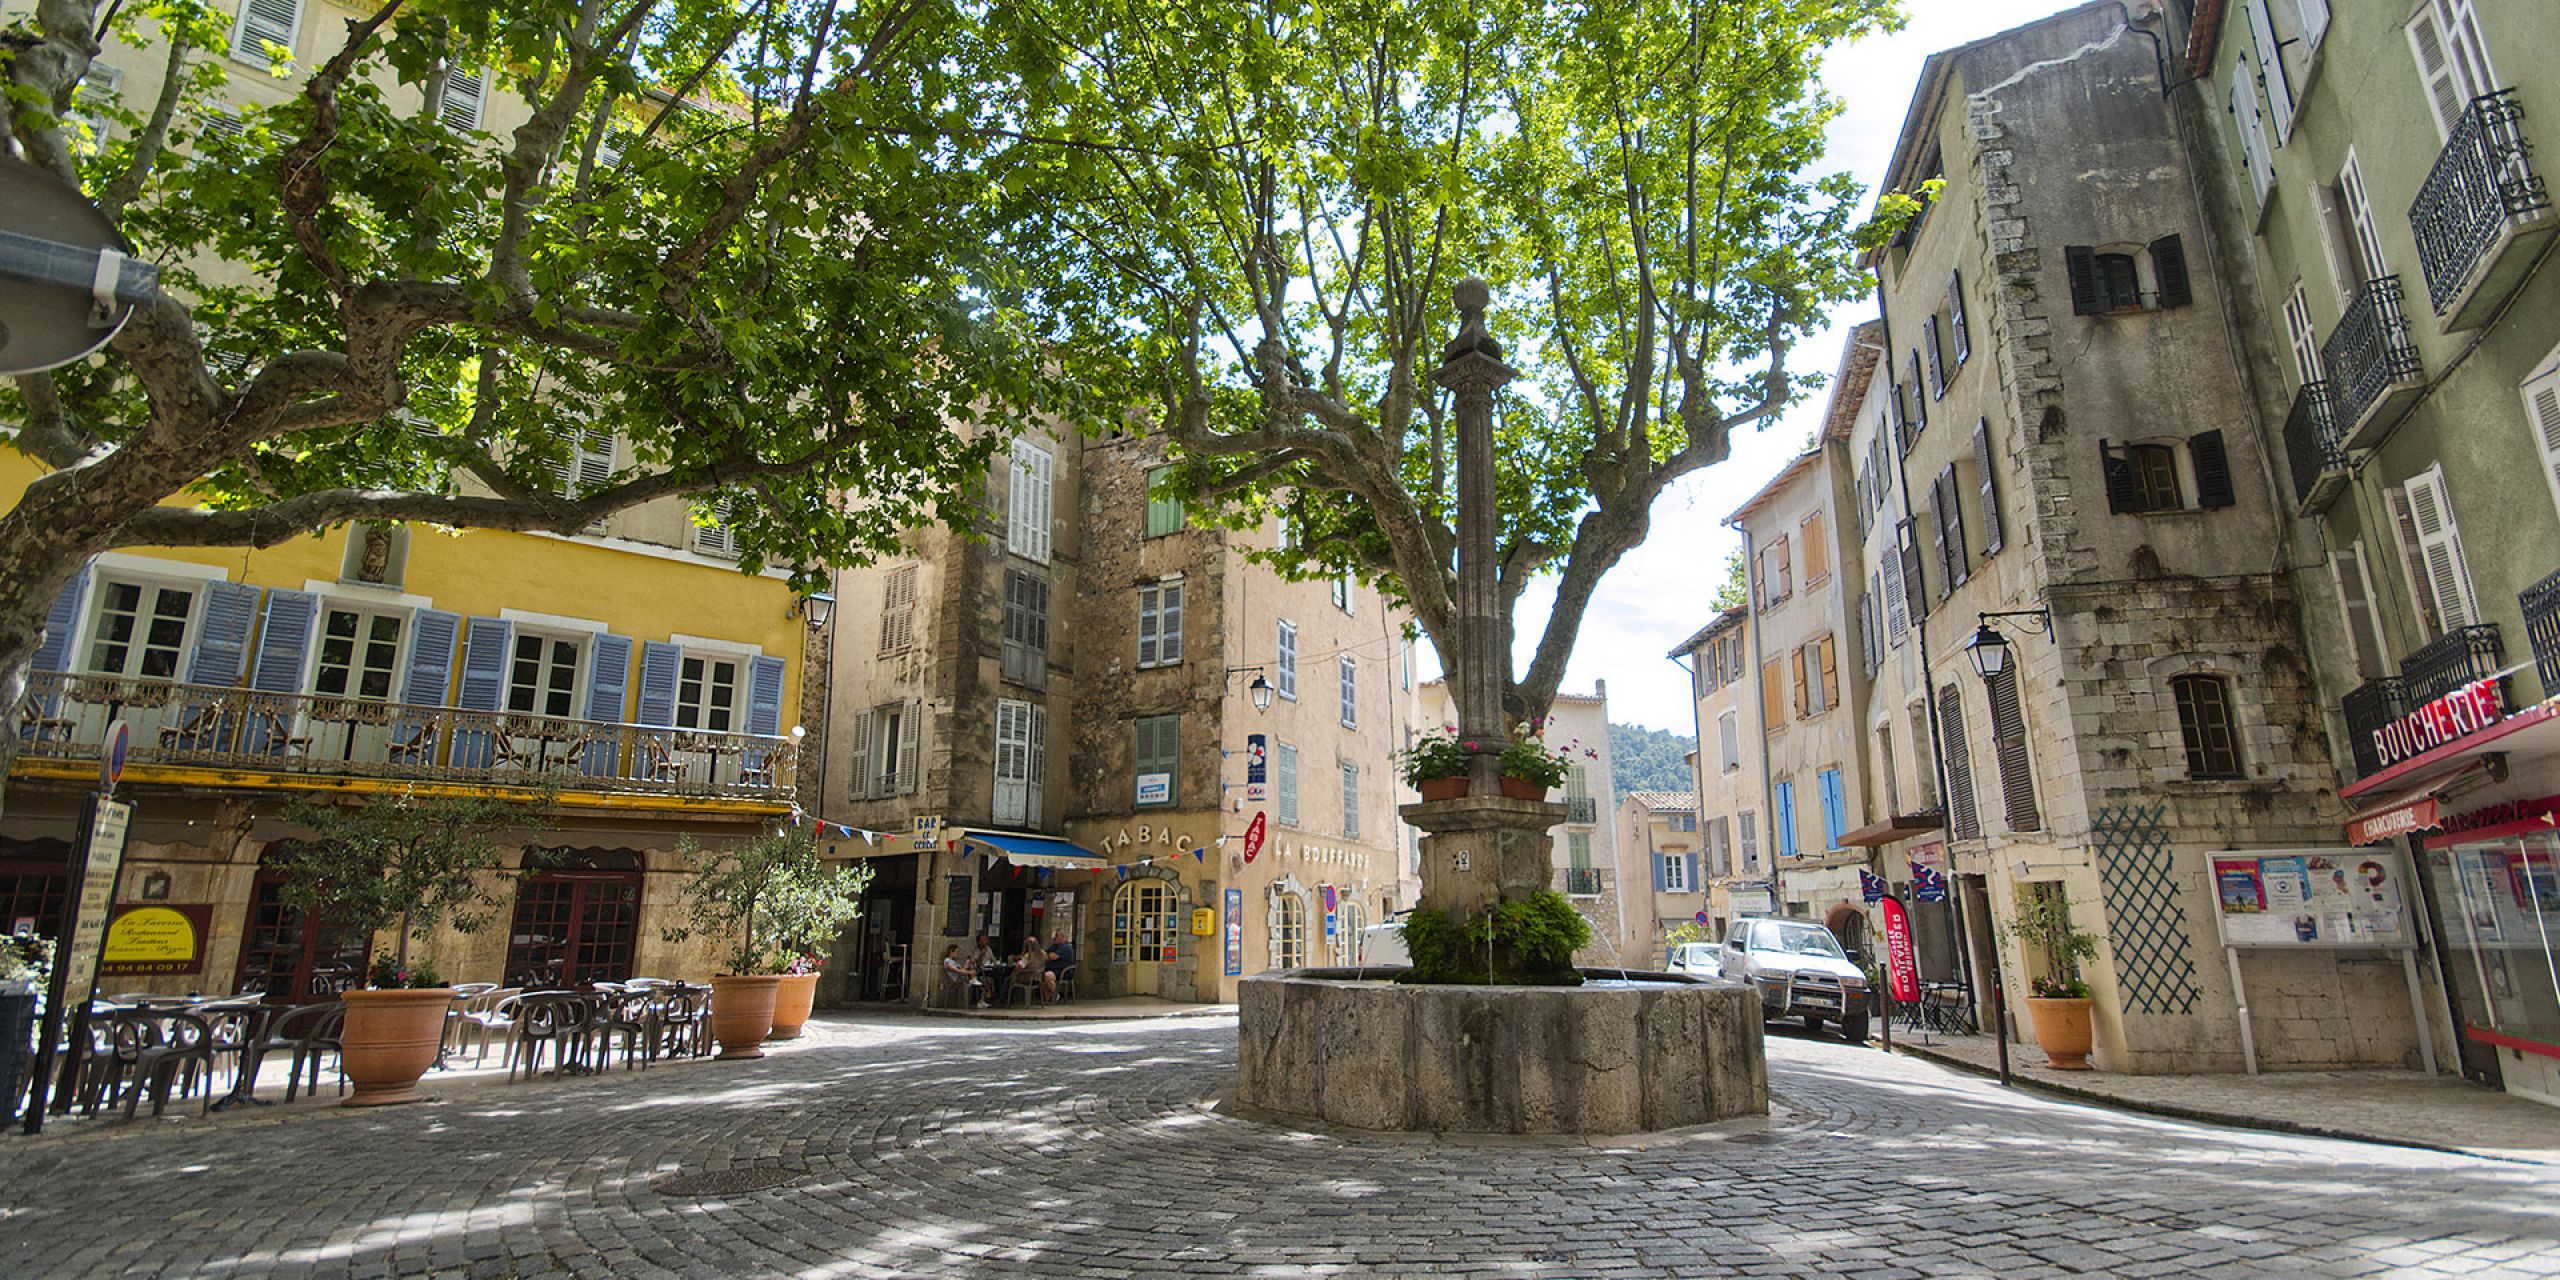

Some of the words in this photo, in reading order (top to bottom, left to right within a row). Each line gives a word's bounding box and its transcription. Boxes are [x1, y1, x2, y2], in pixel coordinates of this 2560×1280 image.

[2372, 680, 2494, 766] BOUCHERIE
[917, 817, 937, 830] BAR
[2363, 807, 2417, 837] CHARCUTERIE
[1100, 824, 1193, 854] TABAC
[1246, 817, 1264, 858] TABAC
[1275, 832, 1292, 857] LA
[1303, 844, 1370, 869] BOUFFARDE
[118, 963, 132, 972] 94
[156, 963, 173, 972] 09
[178, 963, 188, 972] 17
